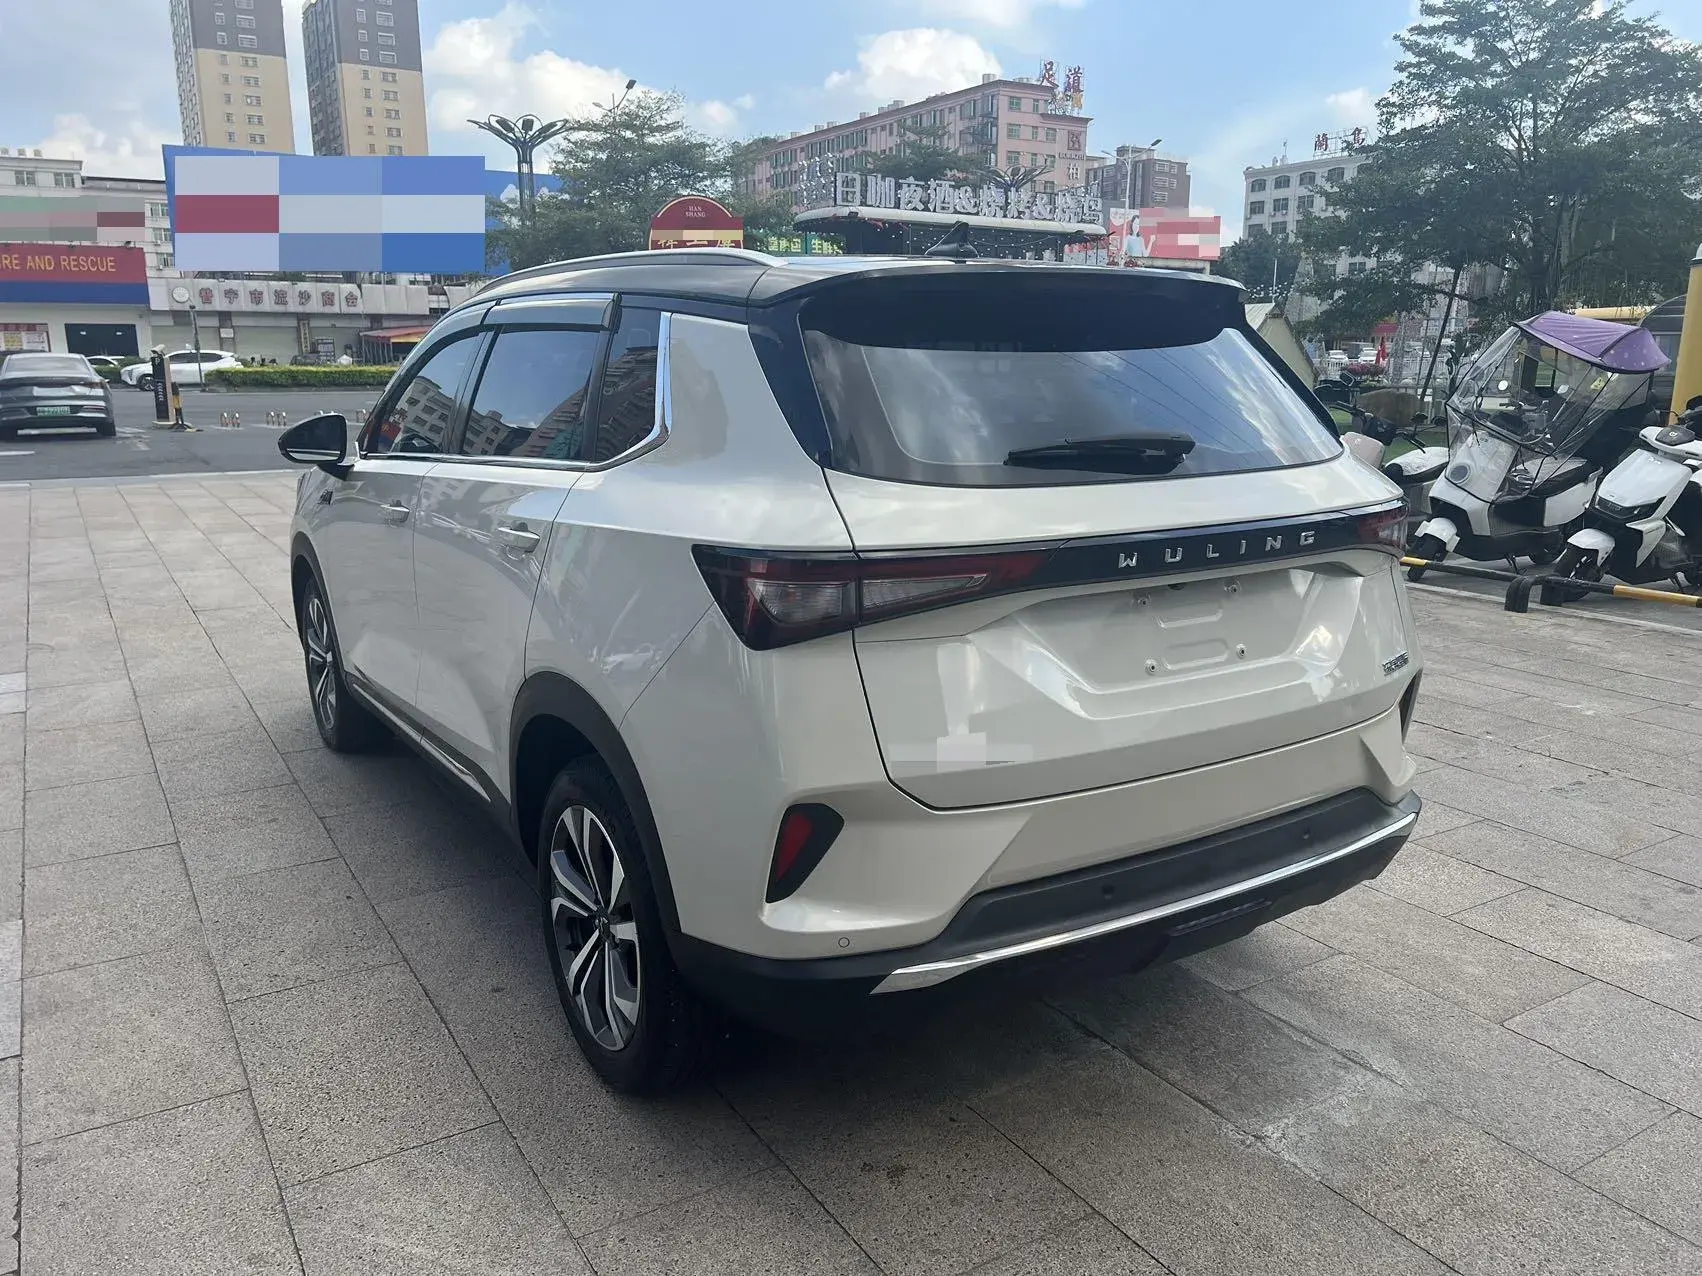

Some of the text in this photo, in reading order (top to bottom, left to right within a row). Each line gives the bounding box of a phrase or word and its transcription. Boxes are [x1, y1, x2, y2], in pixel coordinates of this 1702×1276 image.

[0, 254, 116, 272] RE AND RESCUE
[199, 287, 358, 307] 普宁市流沙商会
[1117, 530, 1315, 568] WULING
